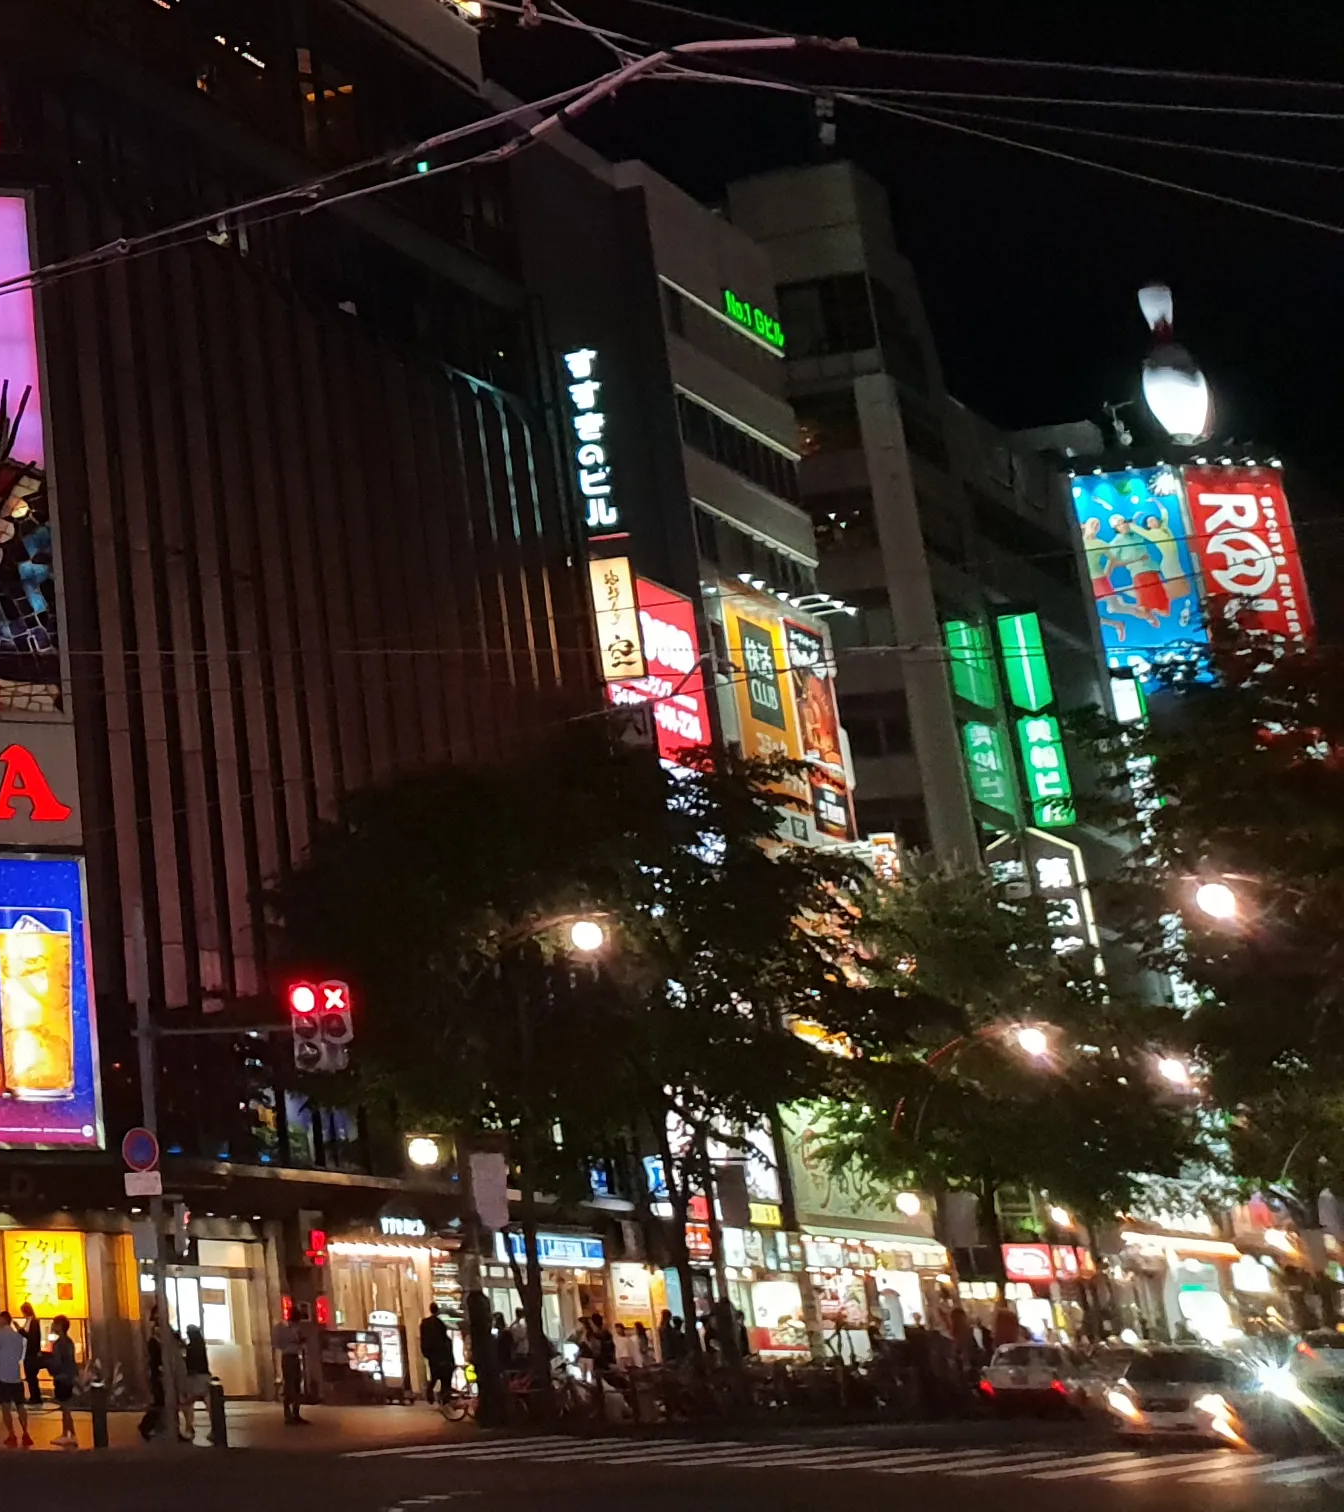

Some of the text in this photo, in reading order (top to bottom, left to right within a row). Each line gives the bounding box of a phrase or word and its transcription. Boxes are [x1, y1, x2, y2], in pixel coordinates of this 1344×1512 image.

[724, 289, 752, 326] No.1
[563, 347, 619, 528] すすきのビル
[749, 677, 779, 711] CLUB
